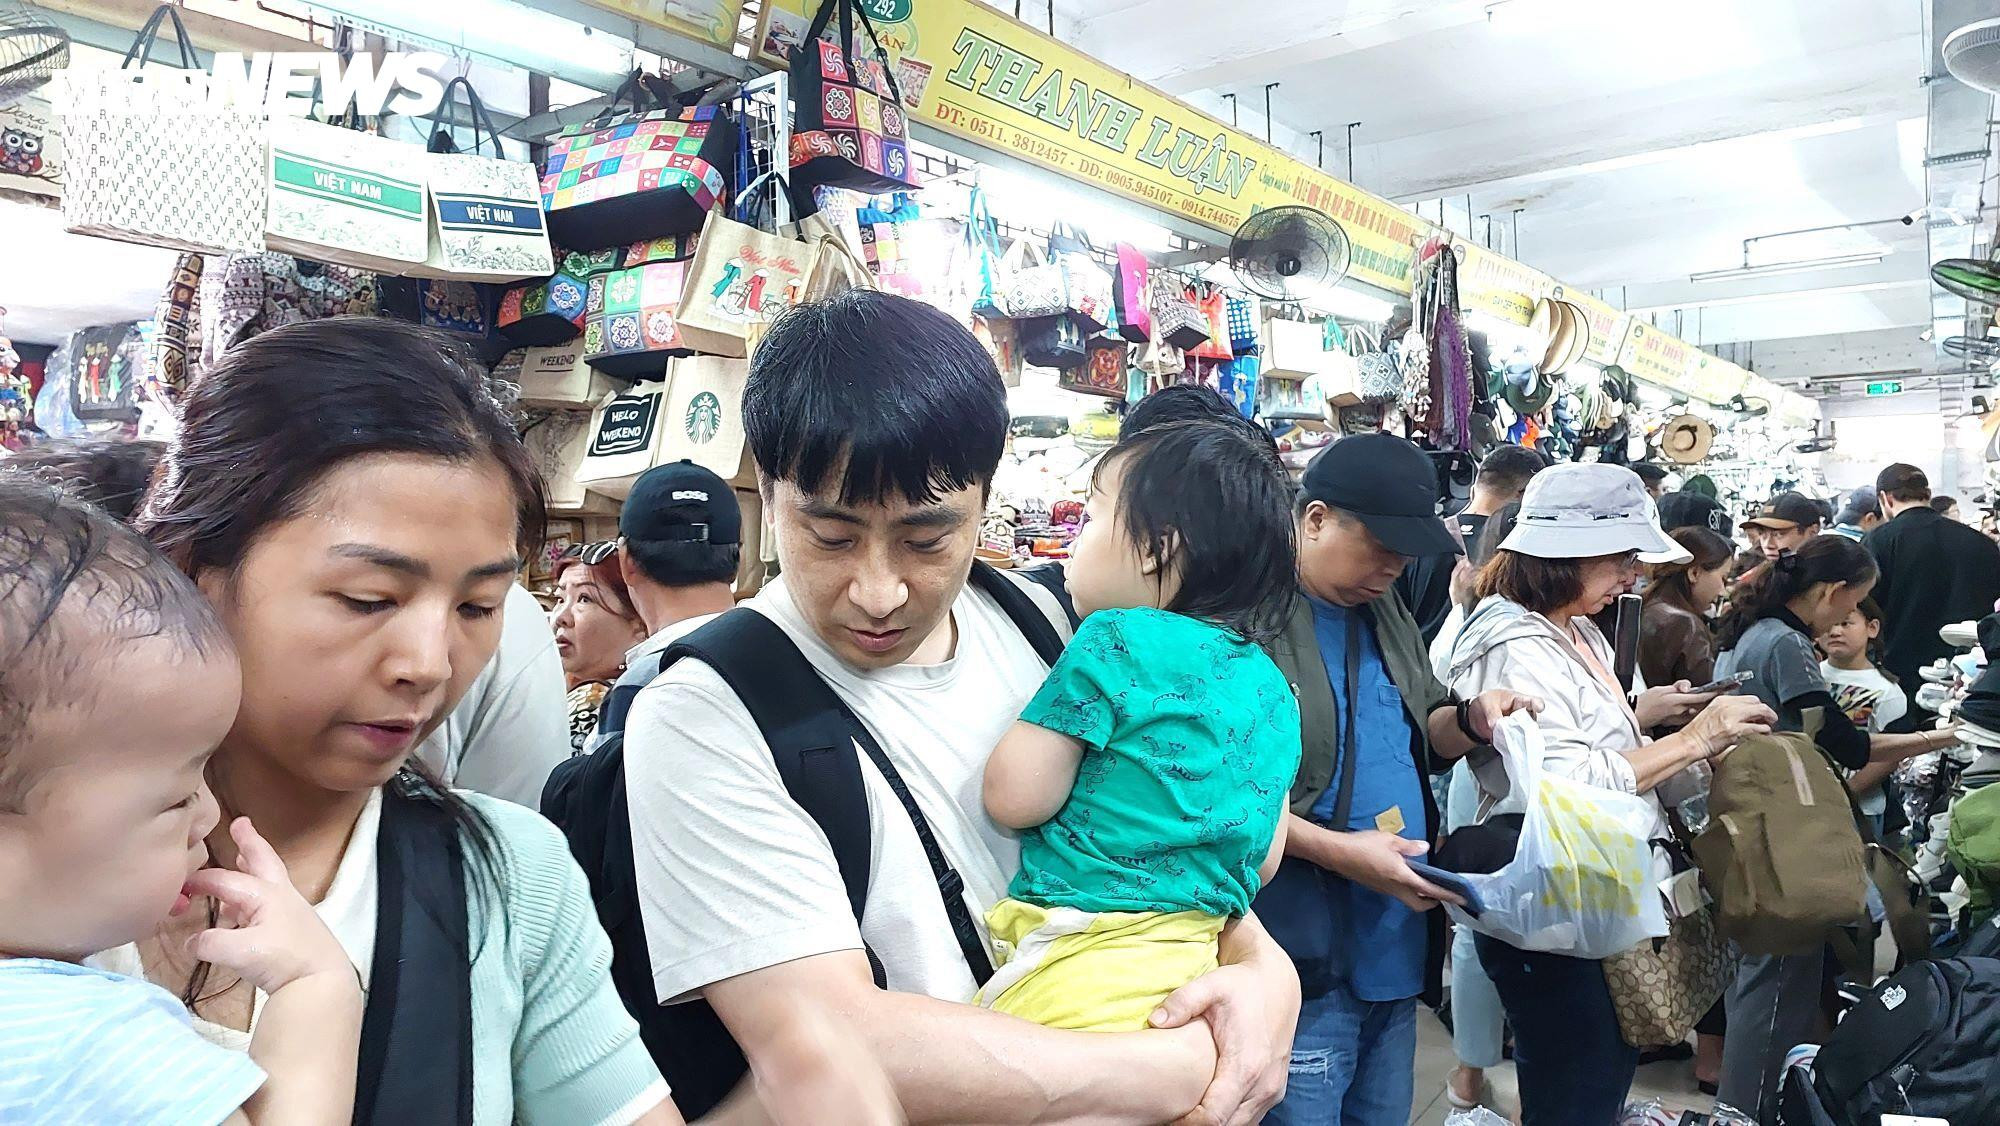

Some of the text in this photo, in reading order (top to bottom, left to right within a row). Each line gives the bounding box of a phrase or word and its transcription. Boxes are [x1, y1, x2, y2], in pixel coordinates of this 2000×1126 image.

[945, 26, 1257, 200] THANH LUẬN
[935, 102, 966, 127] ĐT:
[970, 116, 1008, 143] 0511.
[1012, 133, 1068, 166] 3812457
[1105, 169, 1174, 205] 0905.945107
[1181, 198, 1241, 230] 0914.744575
[313, 171, 383, 201] VIỆT NAM
[465, 203, 514, 224] VIỆT NAM
[540, 354, 575, 367] WEEKEND
[671, 490, 709, 502] BOSS
